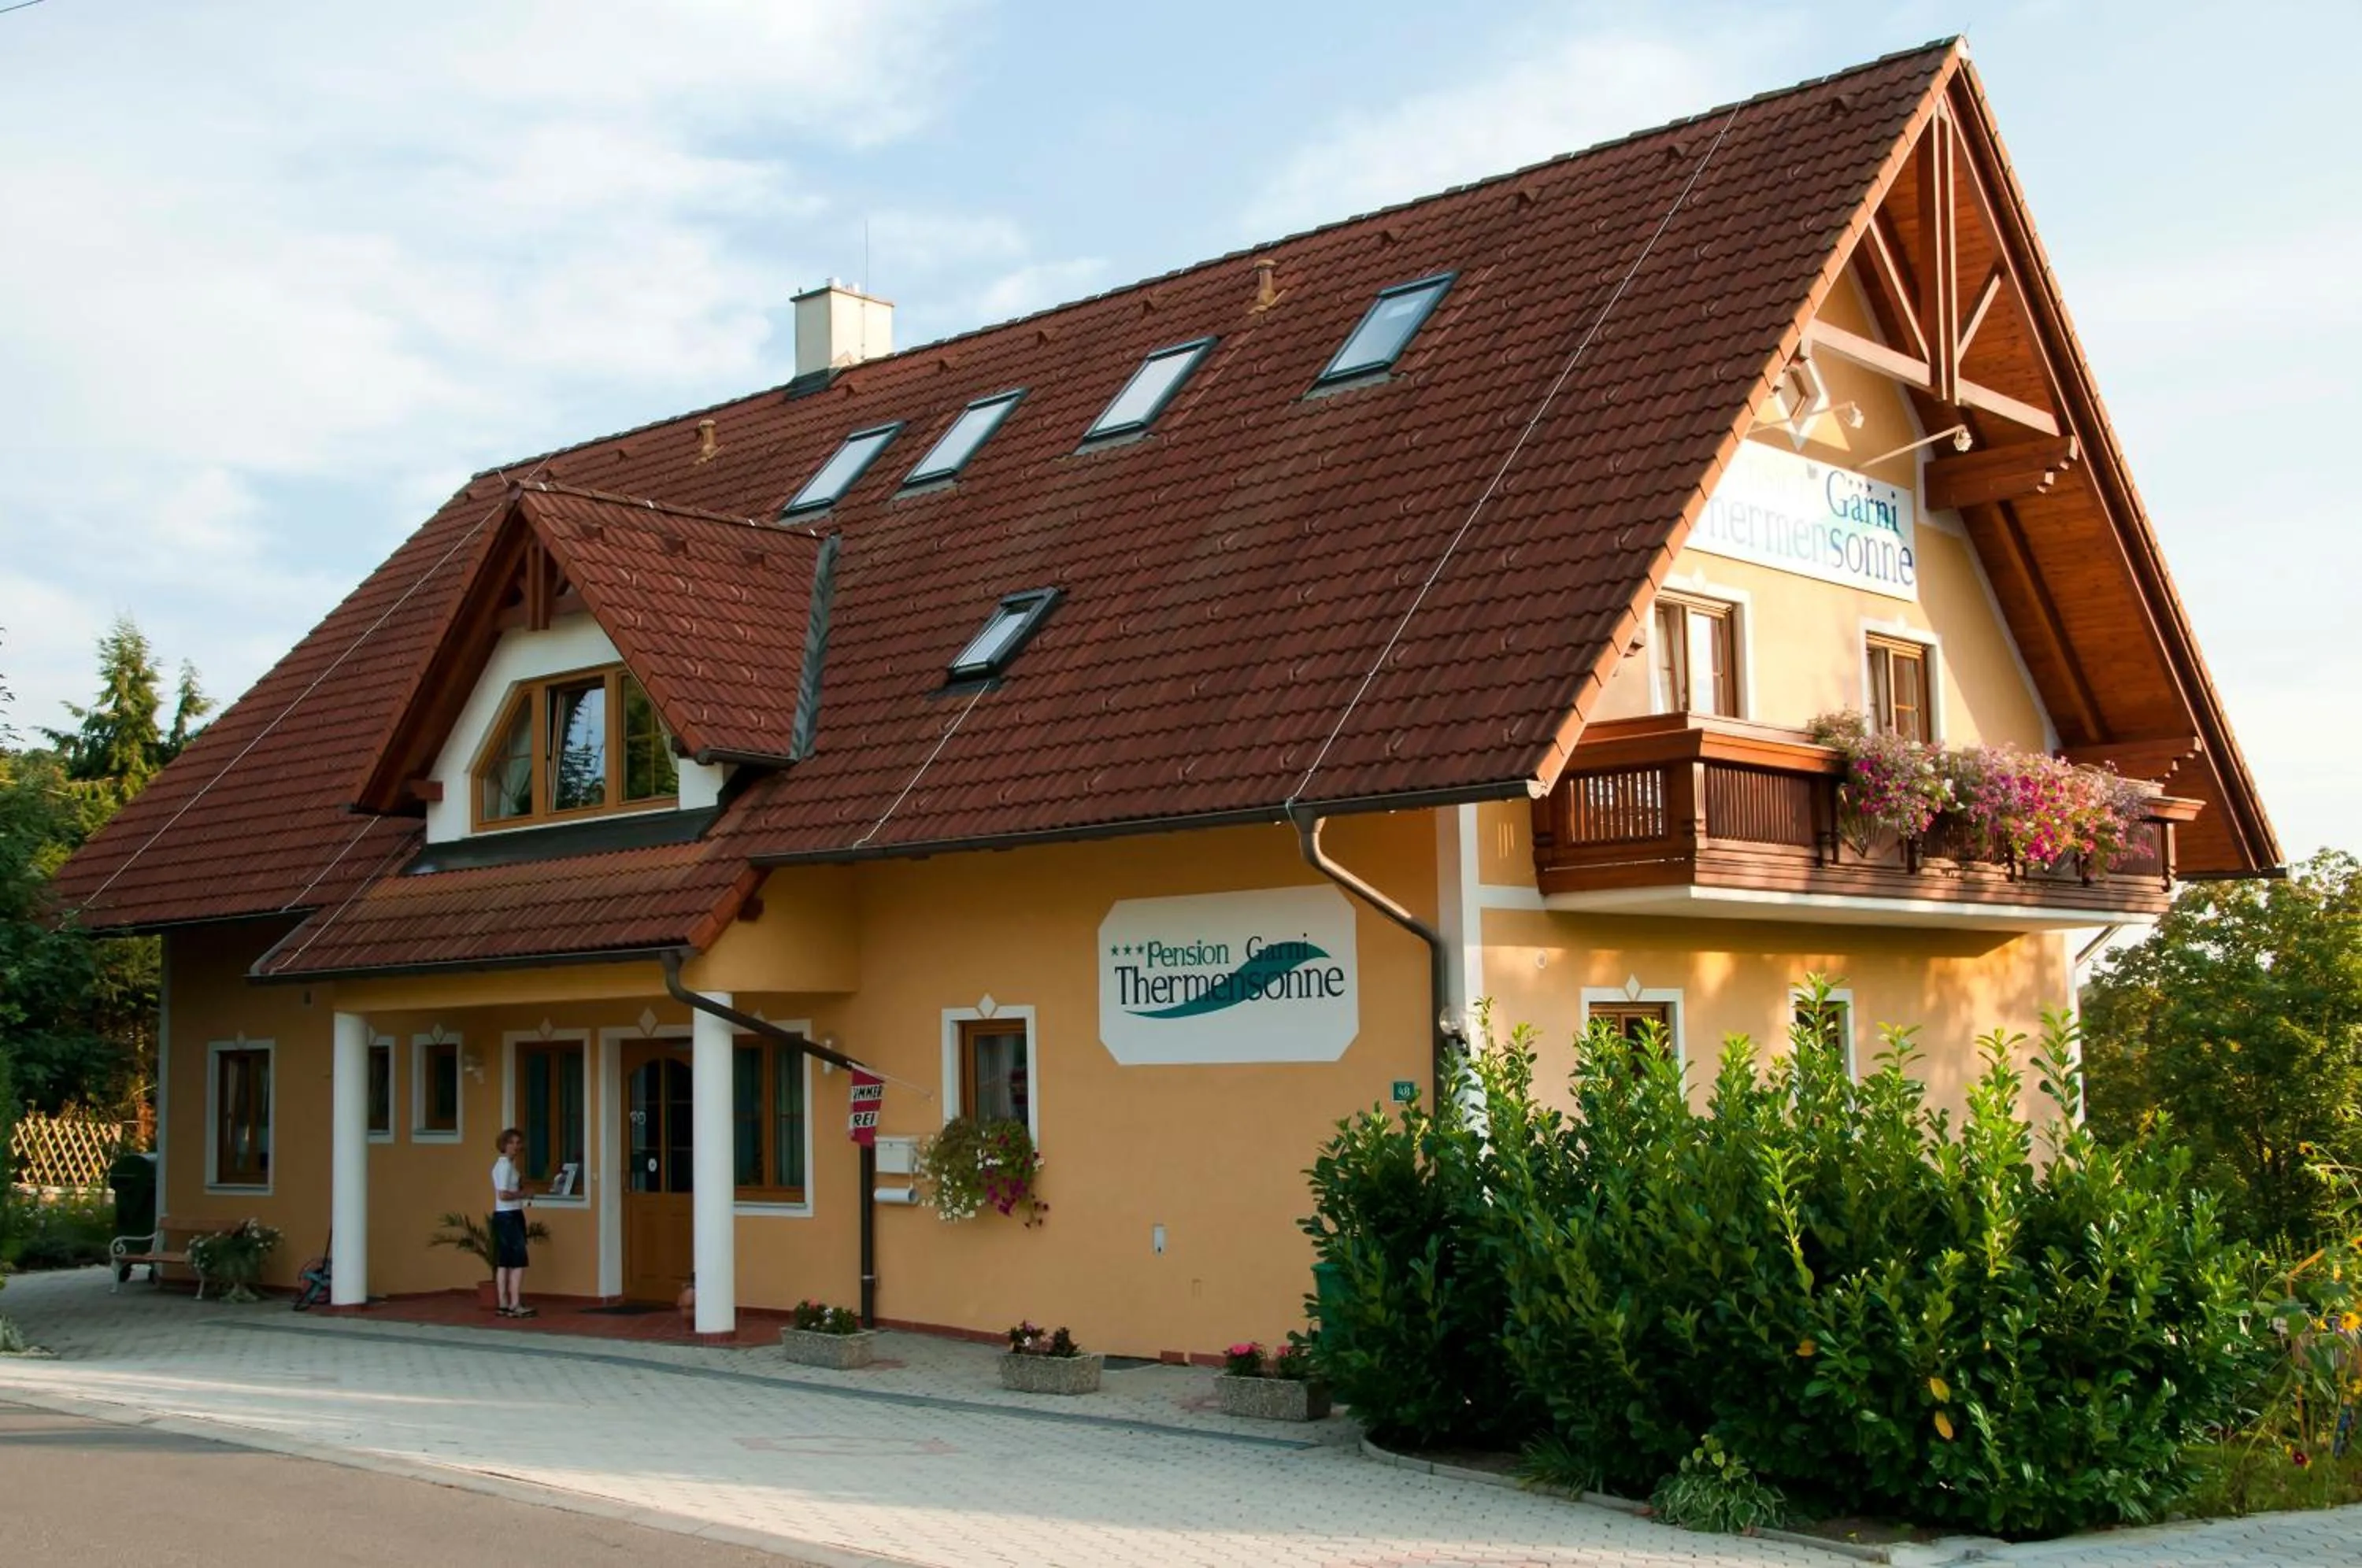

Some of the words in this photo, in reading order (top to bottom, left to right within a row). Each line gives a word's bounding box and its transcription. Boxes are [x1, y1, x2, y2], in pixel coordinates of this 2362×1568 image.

[1827, 470, 1899, 532] Garni
[1694, 495, 1915, 586] hermensonne
[1147, 941, 1229, 967] Pension
[1246, 933, 1309, 962] Garni
[1114, 966, 1345, 1005] Thermensonne
